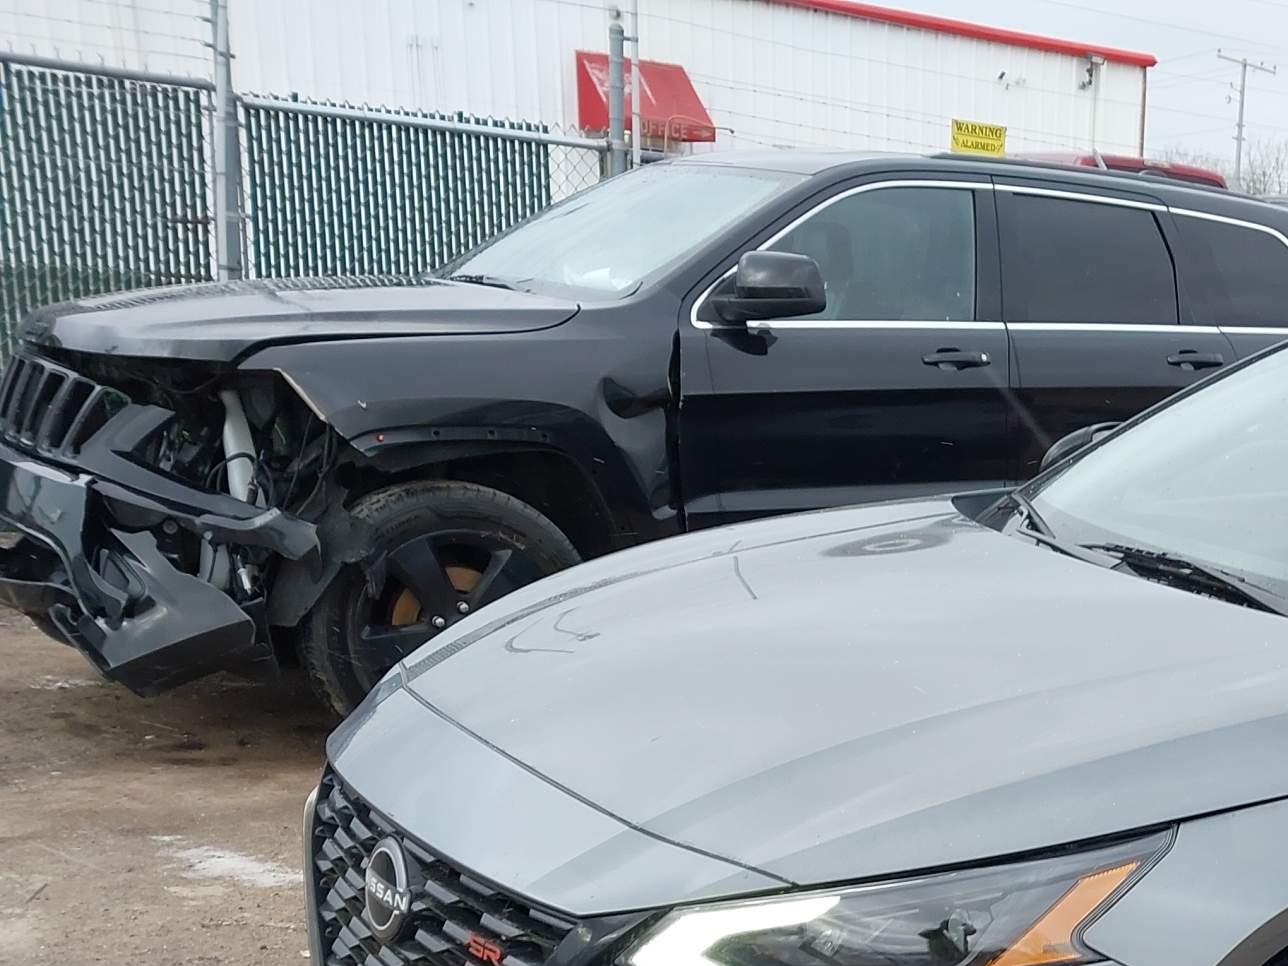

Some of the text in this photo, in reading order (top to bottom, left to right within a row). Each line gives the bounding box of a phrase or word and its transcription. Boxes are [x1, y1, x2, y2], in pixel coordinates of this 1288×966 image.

[640, 121, 688, 138] OFFICE
[955, 121, 1002, 138] WARNING
[961, 138, 996, 152] ALARMED
[369, 877, 407, 911] SSAN
[468, 932, 502, 966] SR
